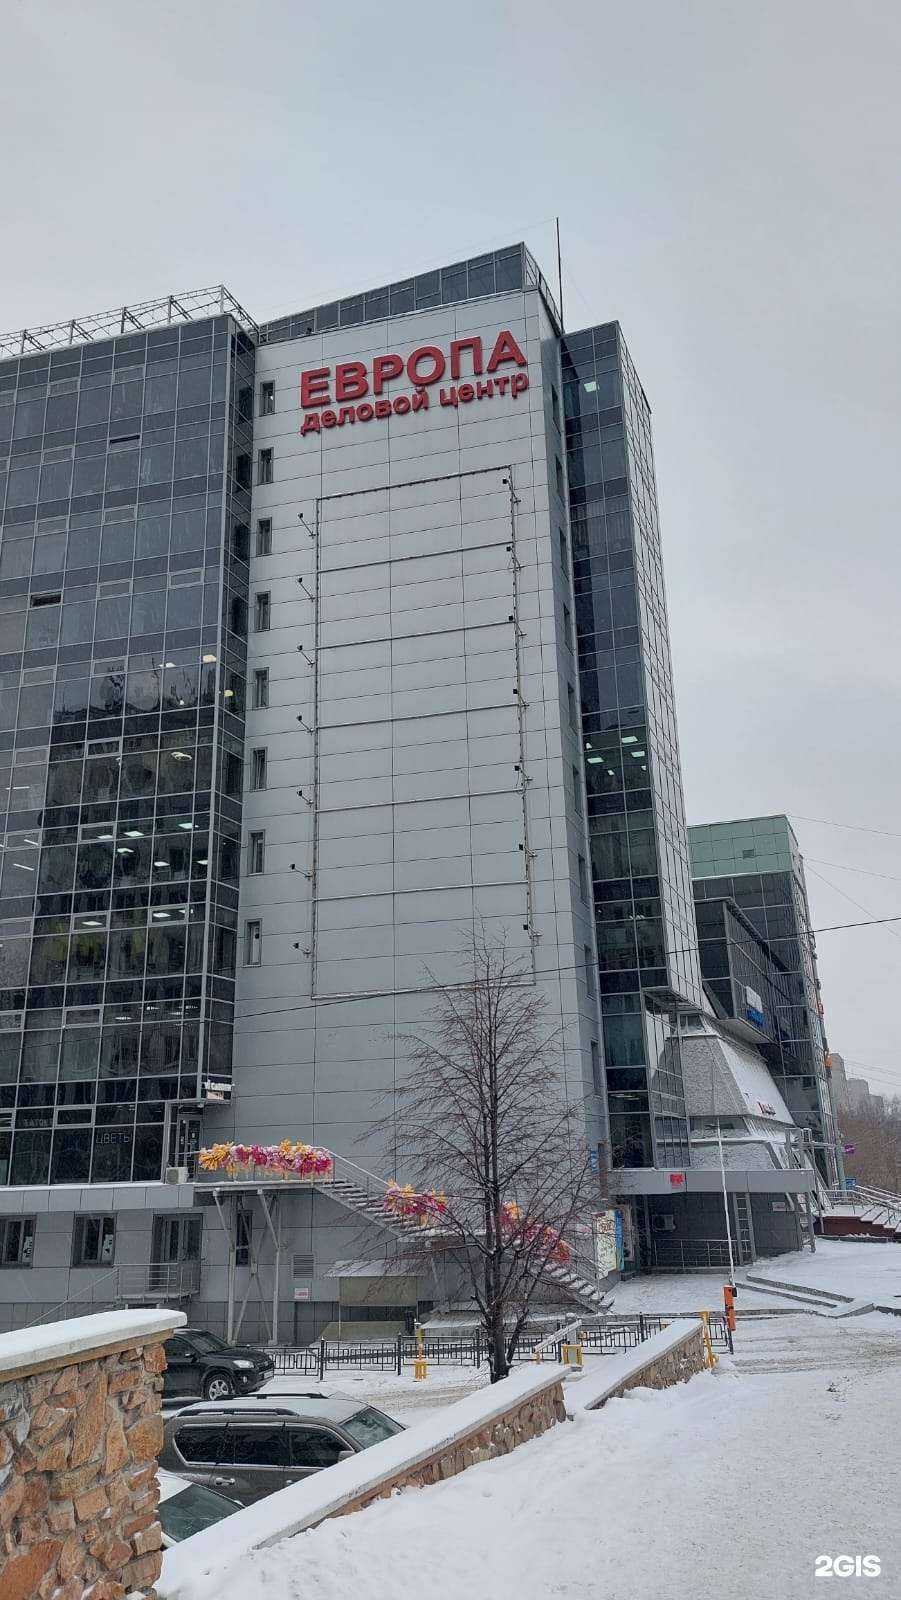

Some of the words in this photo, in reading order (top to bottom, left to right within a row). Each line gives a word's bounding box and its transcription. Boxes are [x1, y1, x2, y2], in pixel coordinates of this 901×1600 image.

[300, 330, 527, 409] ЕВРОПА
[300, 386, 429, 436] деловой
[439, 372, 529, 408] центр
